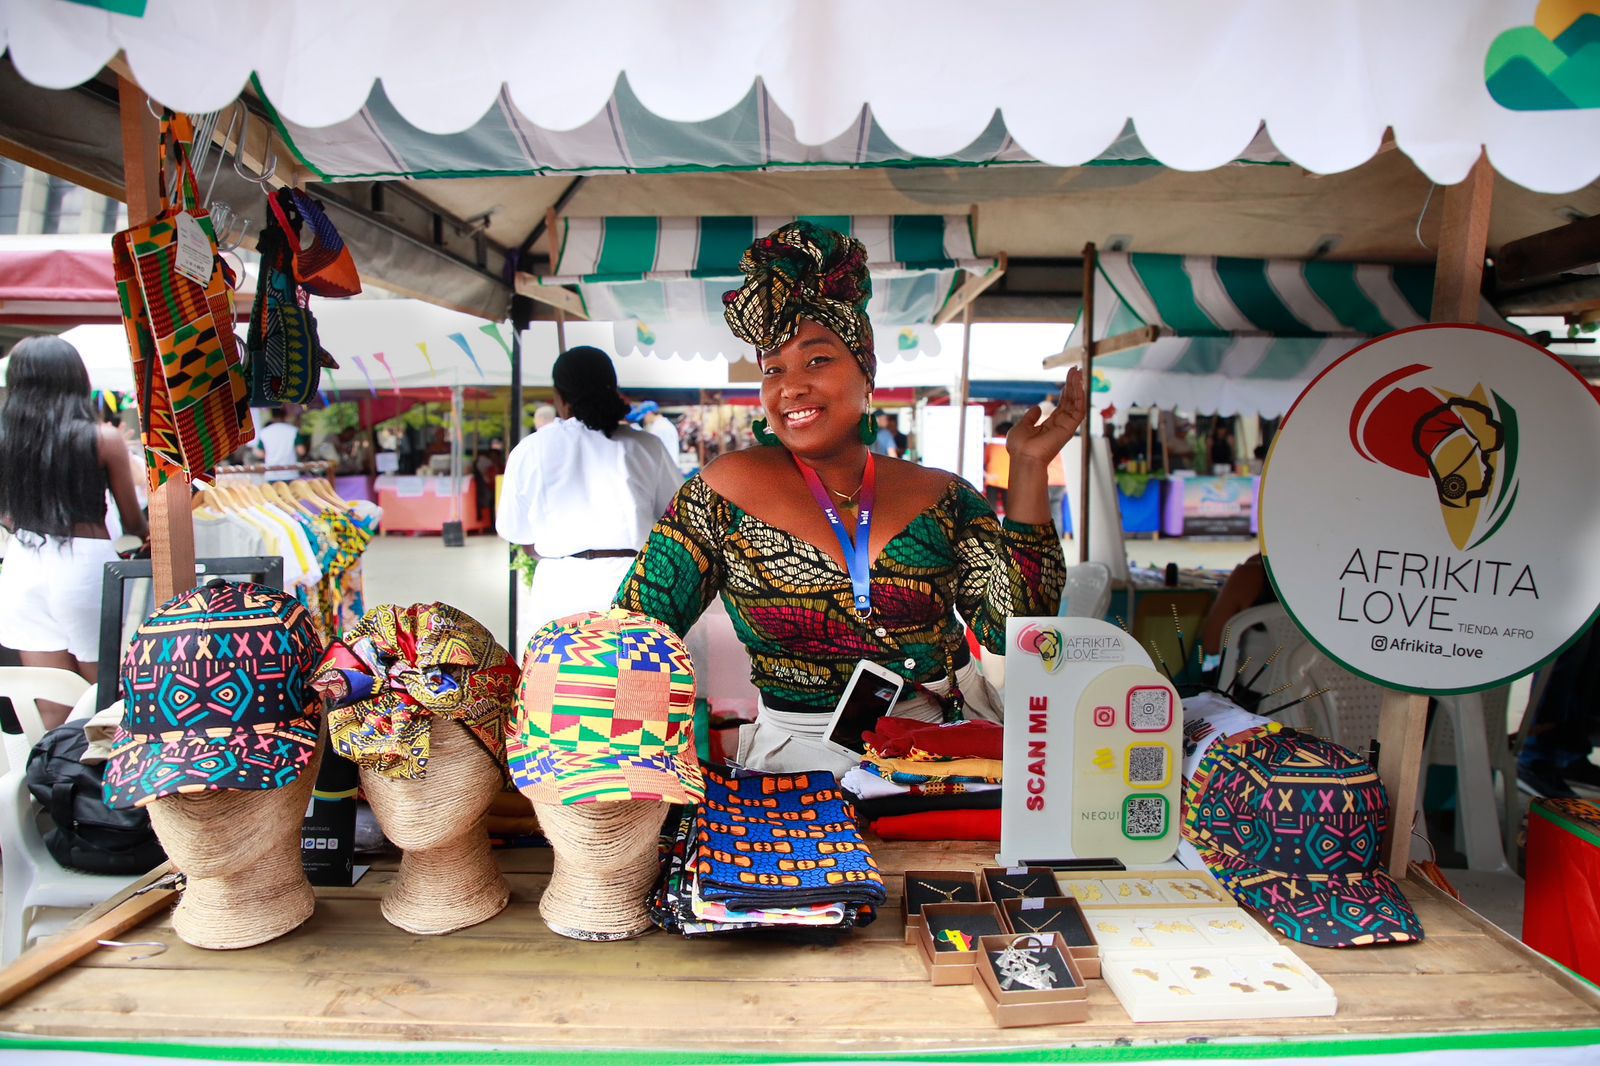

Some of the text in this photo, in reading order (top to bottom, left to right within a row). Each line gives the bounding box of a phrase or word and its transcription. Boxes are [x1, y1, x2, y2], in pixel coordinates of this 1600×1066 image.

[1339, 548, 1539, 600] AFRIKITA
[1338, 587, 1534, 640] LOVE TIENDA AFRO
[1066, 637, 1121, 649] AFRIKITA
[1389, 638, 1484, 659] Afrikita_love
[1066, 649, 1099, 660] LOVE
[1027, 696, 1048, 812] SCAN ME
[1081, 811, 1120, 821] NEQUI
